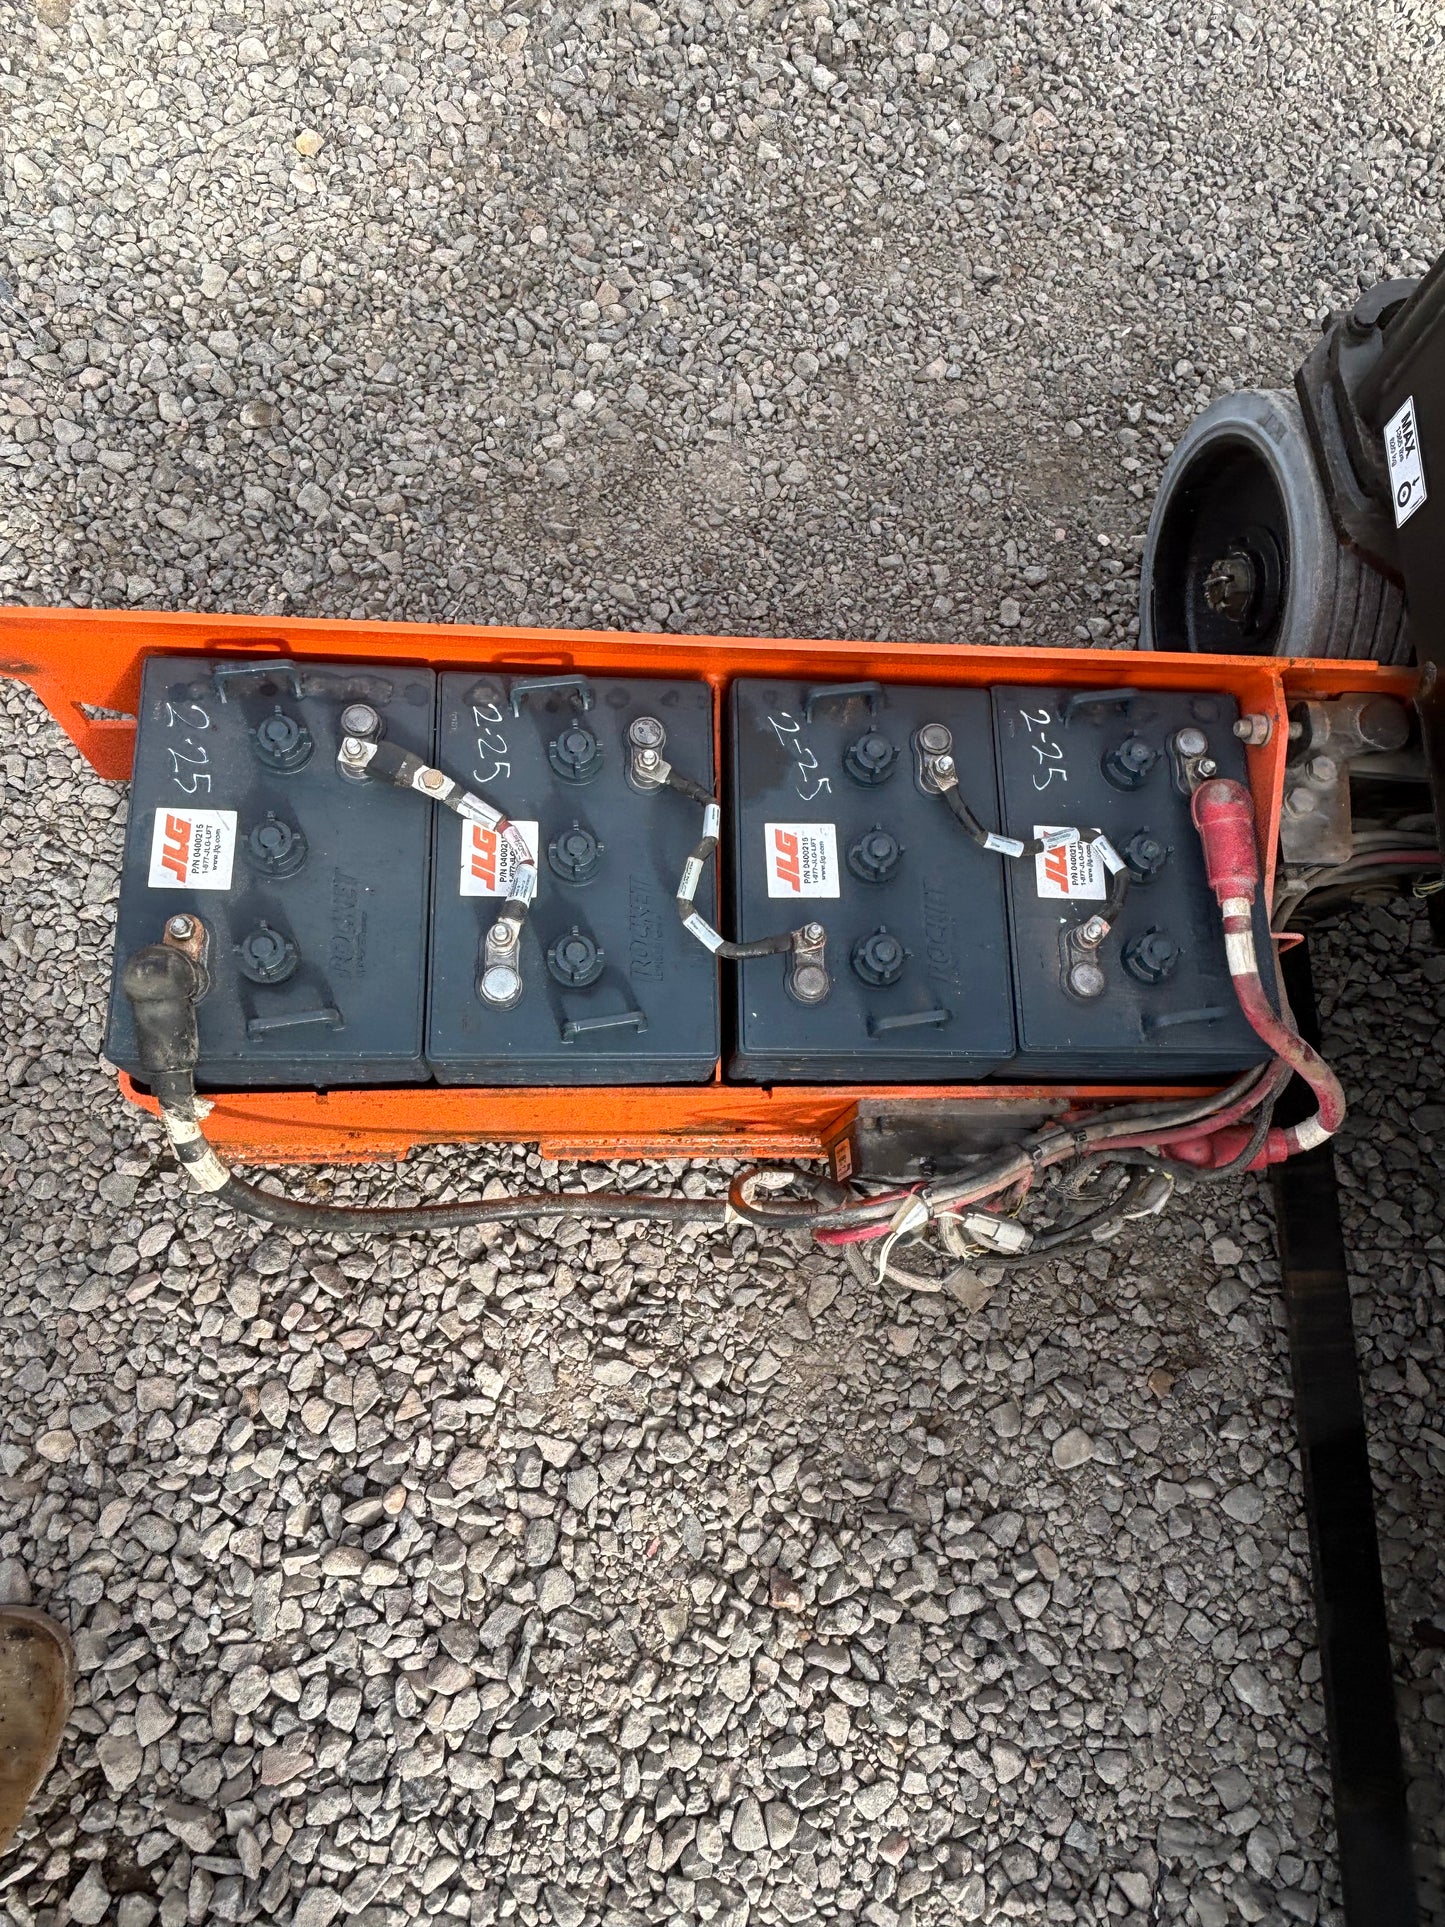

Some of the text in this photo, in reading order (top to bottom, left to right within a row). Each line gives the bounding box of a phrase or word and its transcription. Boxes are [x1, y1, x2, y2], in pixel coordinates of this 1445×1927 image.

[1401, 411, 1415, 459] MAX
[472, 703, 511, 783] 2-25
[767, 711, 832, 801] 2-25
[1019, 709, 1068, 791] 2-25
[161, 814, 191, 883] JLG
[191, 824, 204, 874] P/N 0400215
[471, 825, 496, 891] JLG
[775, 829, 800, 892] JLG
[802, 837, 811, 883] P/N 0400215
